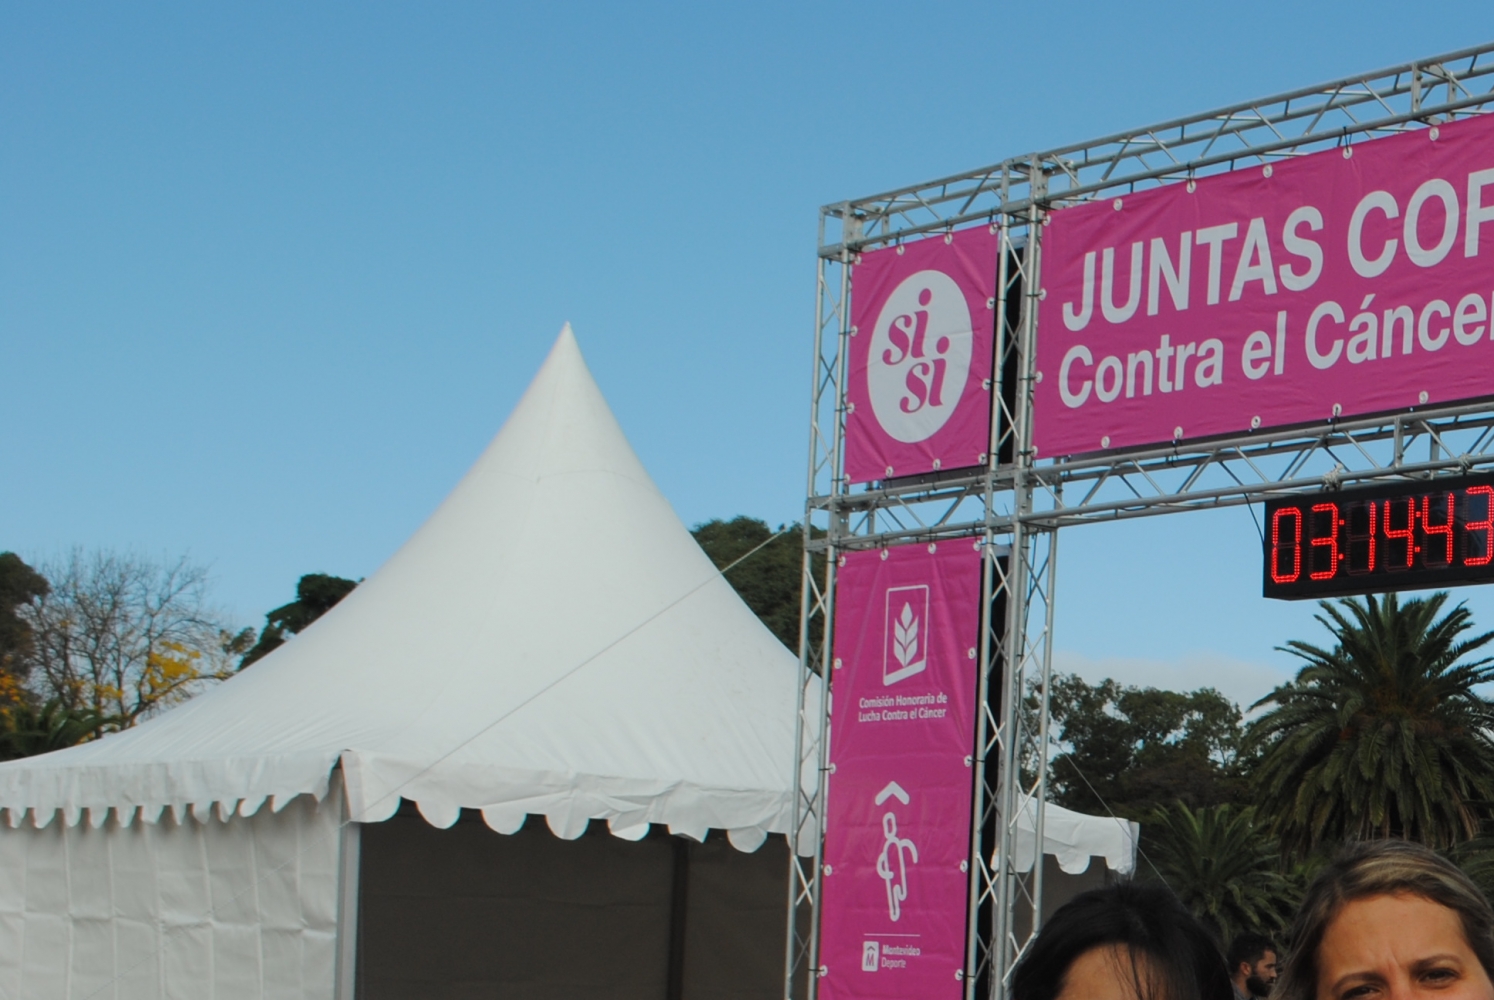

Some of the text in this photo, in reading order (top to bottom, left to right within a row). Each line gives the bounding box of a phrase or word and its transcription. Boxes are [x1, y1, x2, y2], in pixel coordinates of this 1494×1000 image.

[1062, 206, 1324, 332] JUNTAS
[882, 288, 932, 366] si
[1058, 334, 1223, 408] Contra
[1241, 311, 1287, 381] el
[899, 336, 950, 414] si
[858, 706, 946, 722] Lucha Contra el Cáncer
[859, 691, 948, 709] Comisión Honoraria de
